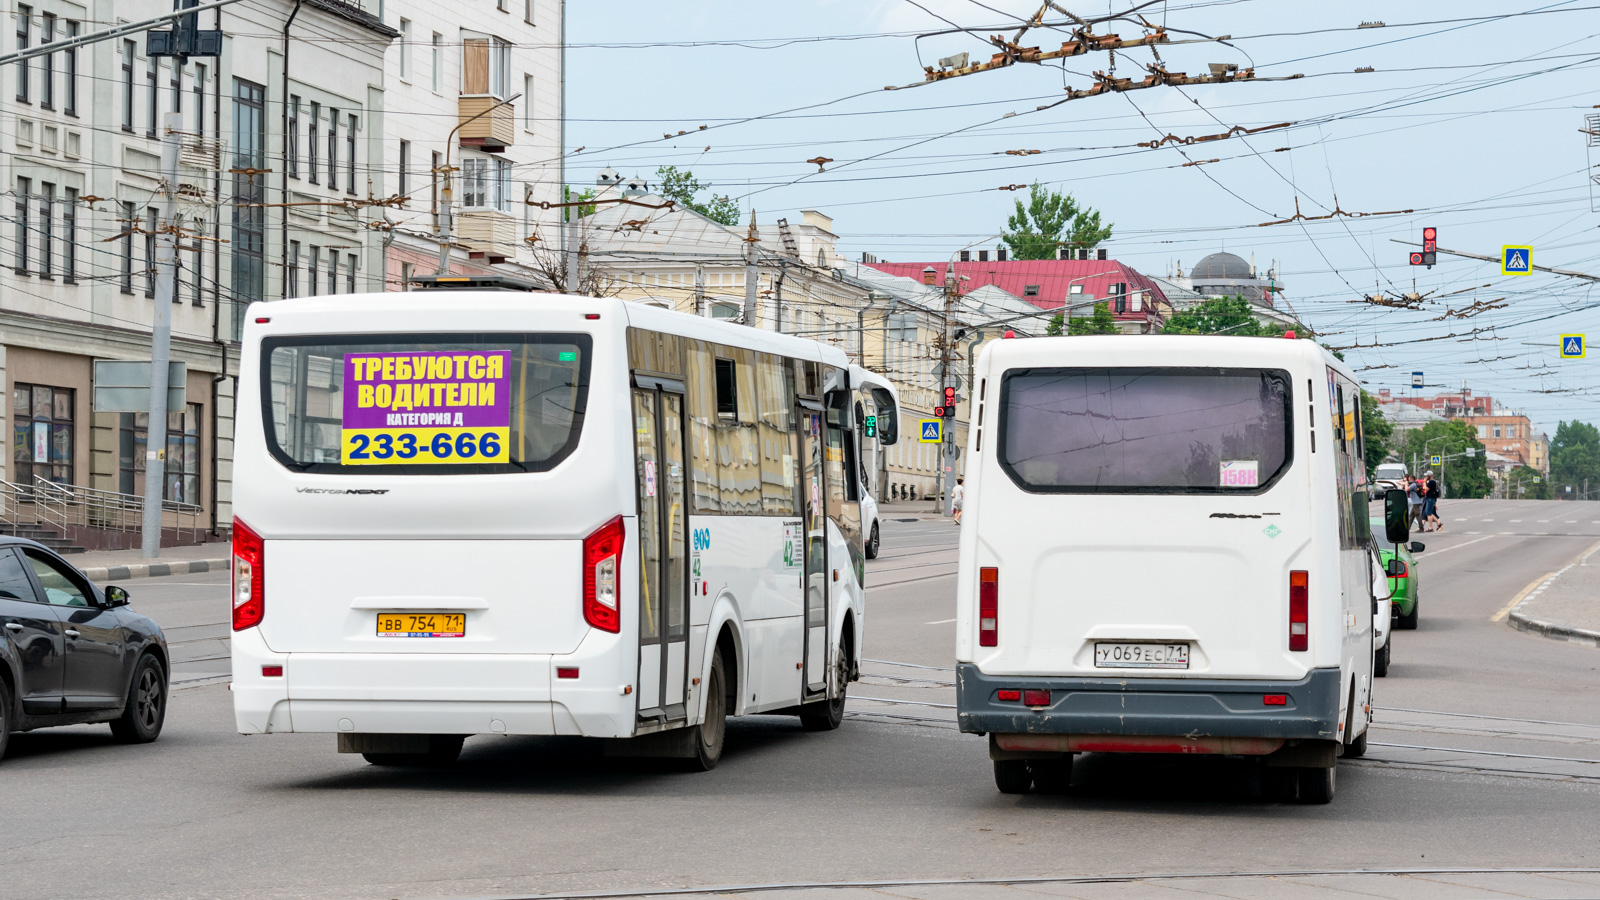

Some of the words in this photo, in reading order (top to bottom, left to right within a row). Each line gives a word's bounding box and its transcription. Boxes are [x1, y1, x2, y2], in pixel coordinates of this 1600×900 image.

[1424, 240, 1436, 252] 27
[351, 355, 504, 381] ТРЕБУЮТСЯ
[358, 383, 496, 411] ВОДИТЕЛИ
[386, 413, 452, 426] КАТЕГОРИЯ
[453, 412, 464, 427] Д
[349, 432, 501, 460] 233-666
[783, 540, 793, 567] 42
[693, 558, 701, 577] 42
[409, 616, 436, 631] 754
[445, 615, 459, 627] 71
[1167, 646, 1182, 658] 71
